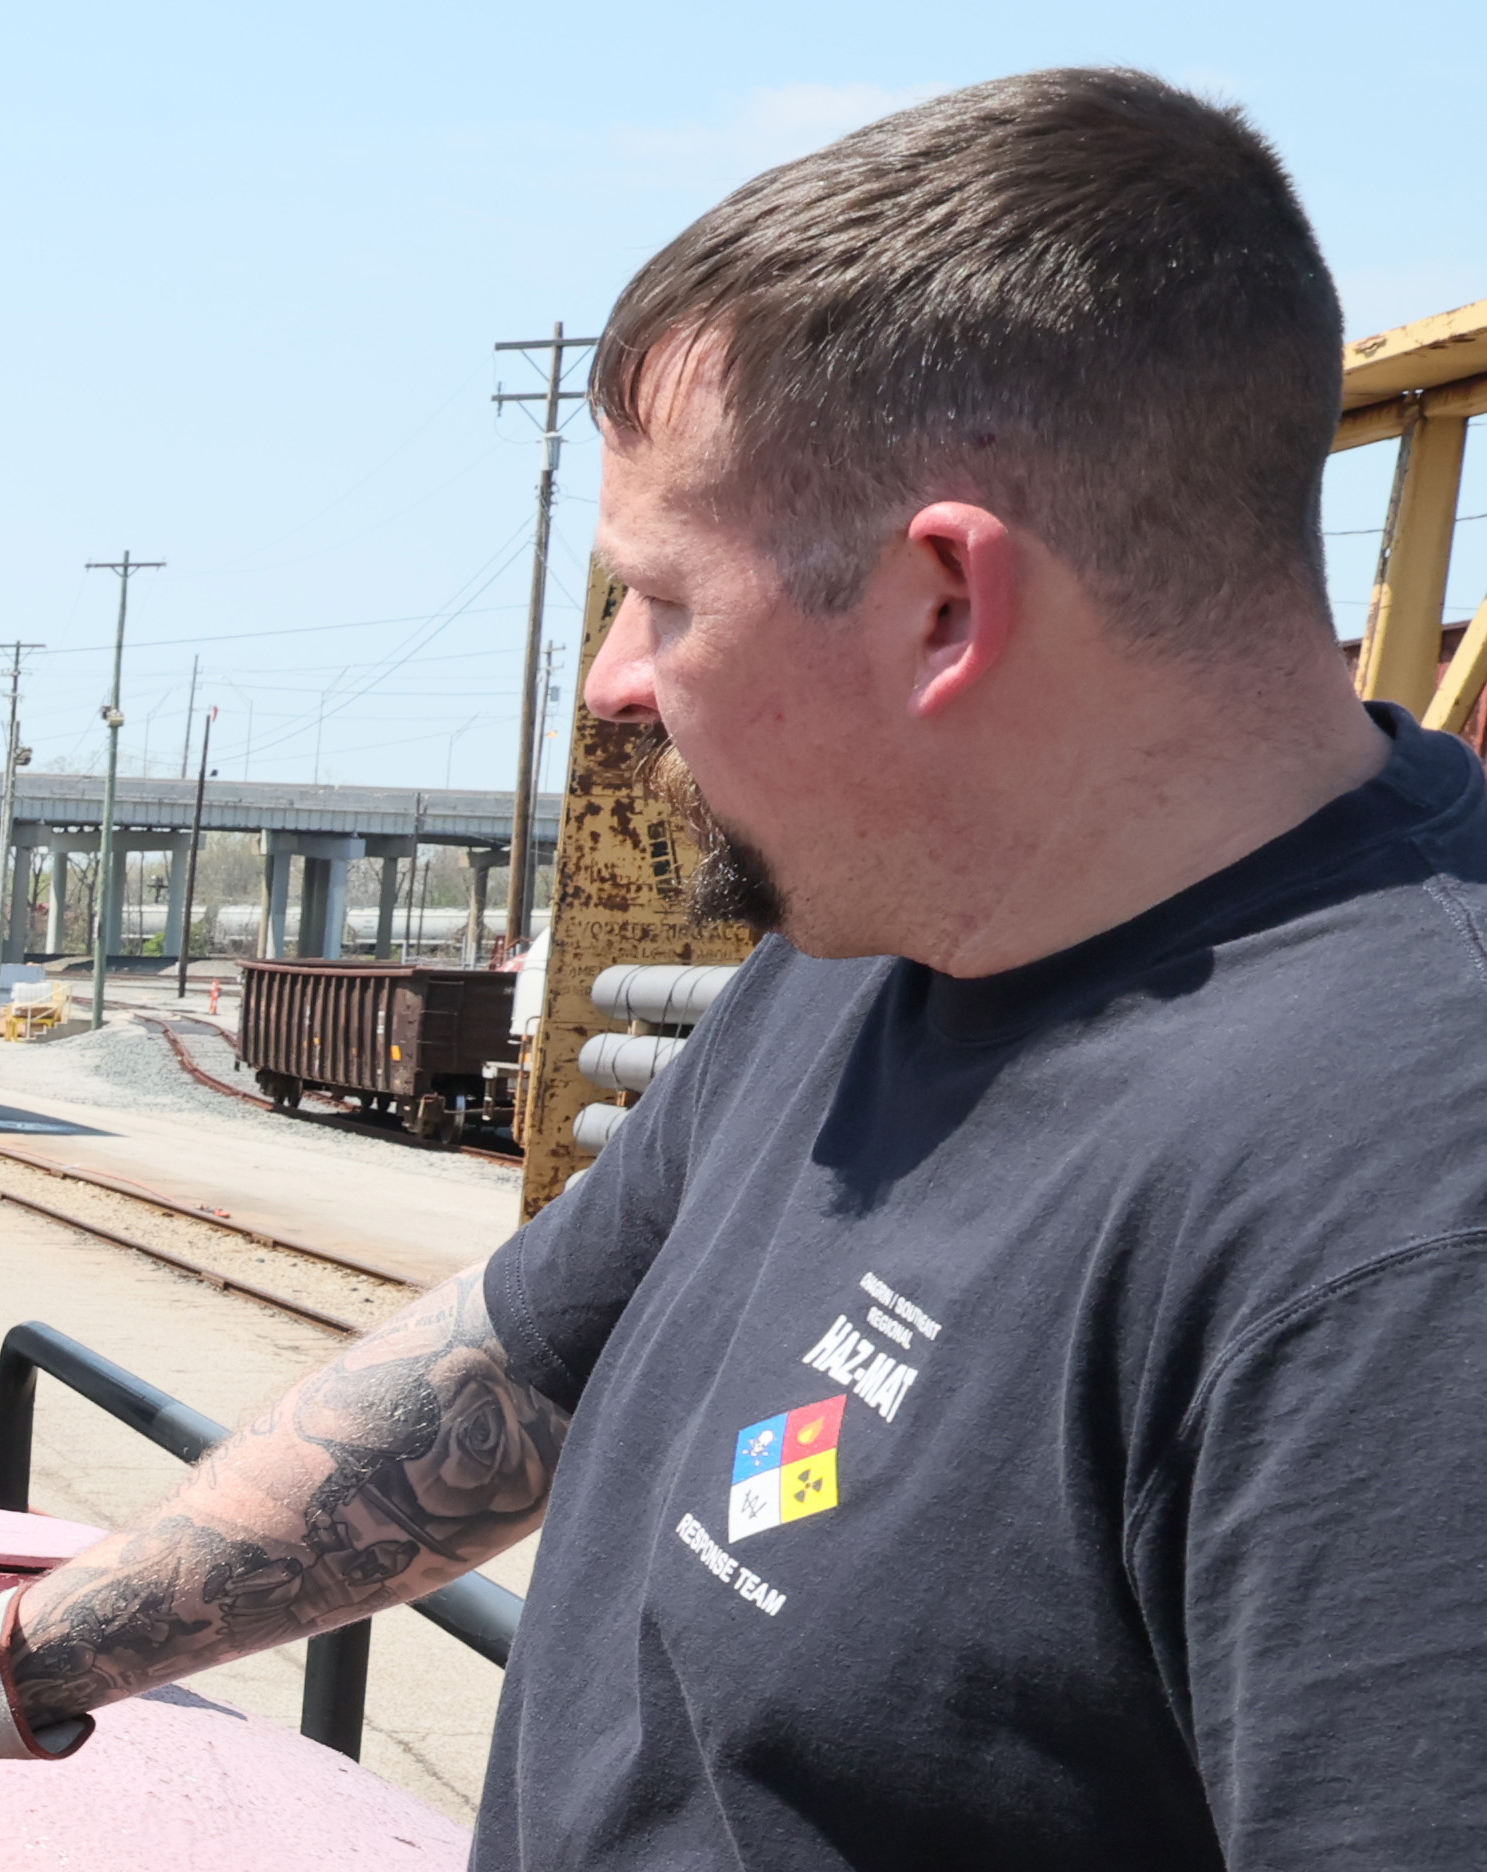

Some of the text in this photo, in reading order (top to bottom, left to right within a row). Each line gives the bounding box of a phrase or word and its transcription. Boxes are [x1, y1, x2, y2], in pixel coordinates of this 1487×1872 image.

[866, 1306, 913, 1350] REGIONAL
[894, 1296, 942, 1341] SOUTHEAST
[675, 1512, 787, 1616] RESPONSE TEAM
